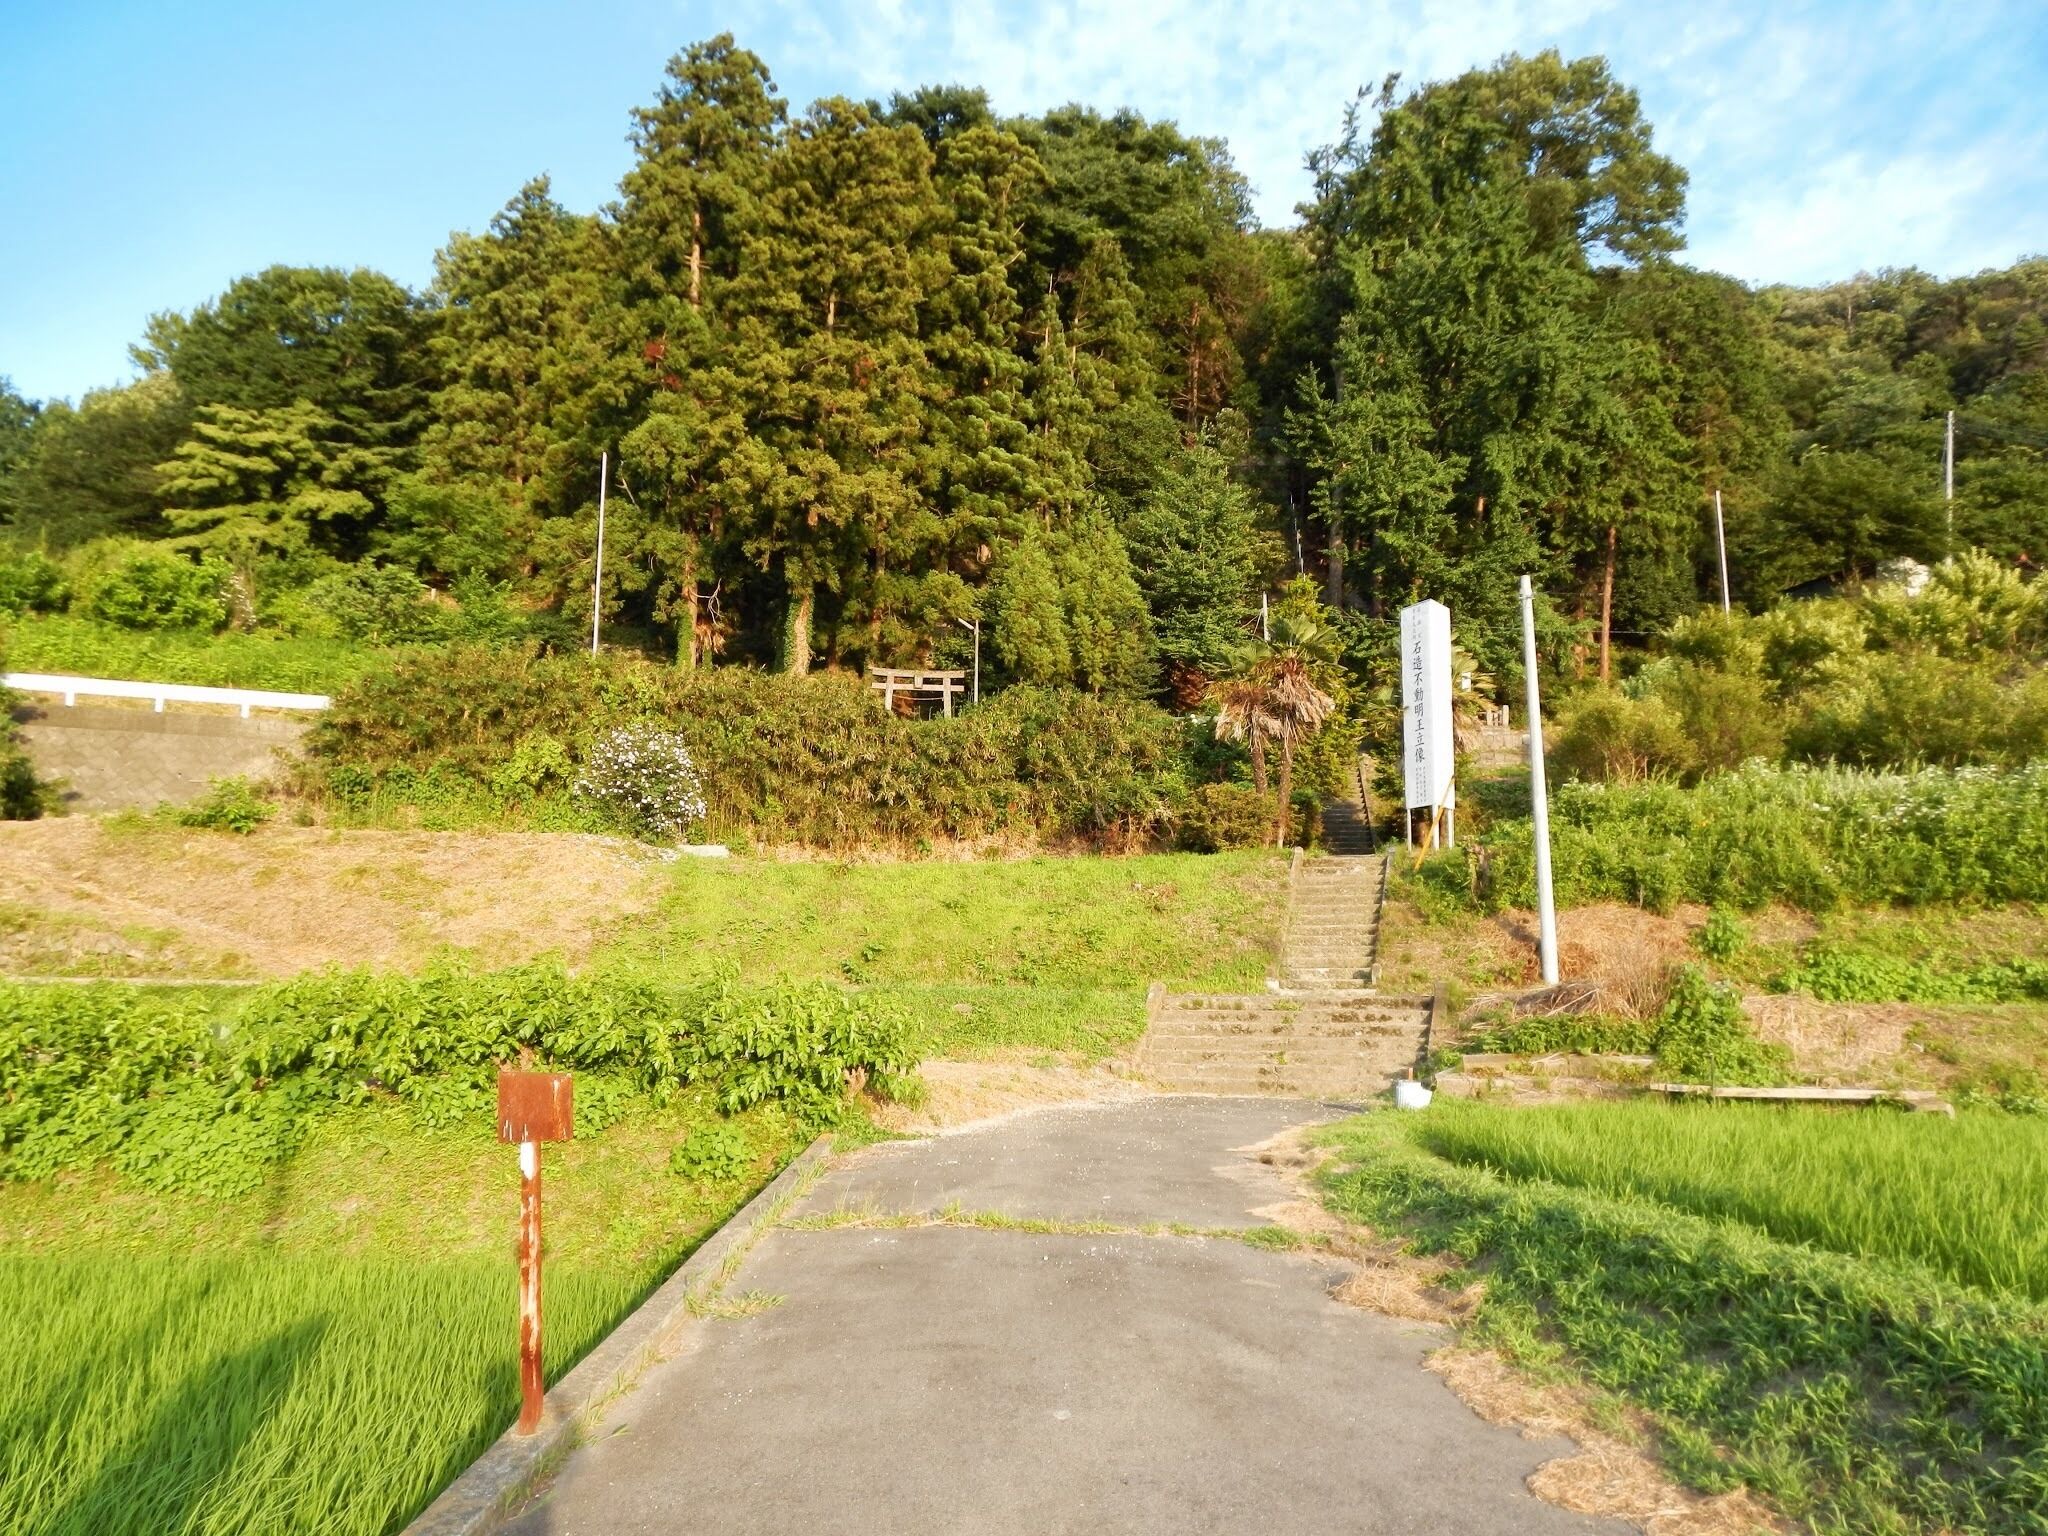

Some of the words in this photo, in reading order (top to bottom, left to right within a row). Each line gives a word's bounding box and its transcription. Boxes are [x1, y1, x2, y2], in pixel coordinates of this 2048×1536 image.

[1413, 641, 1425, 763] 石造不動明王立像
